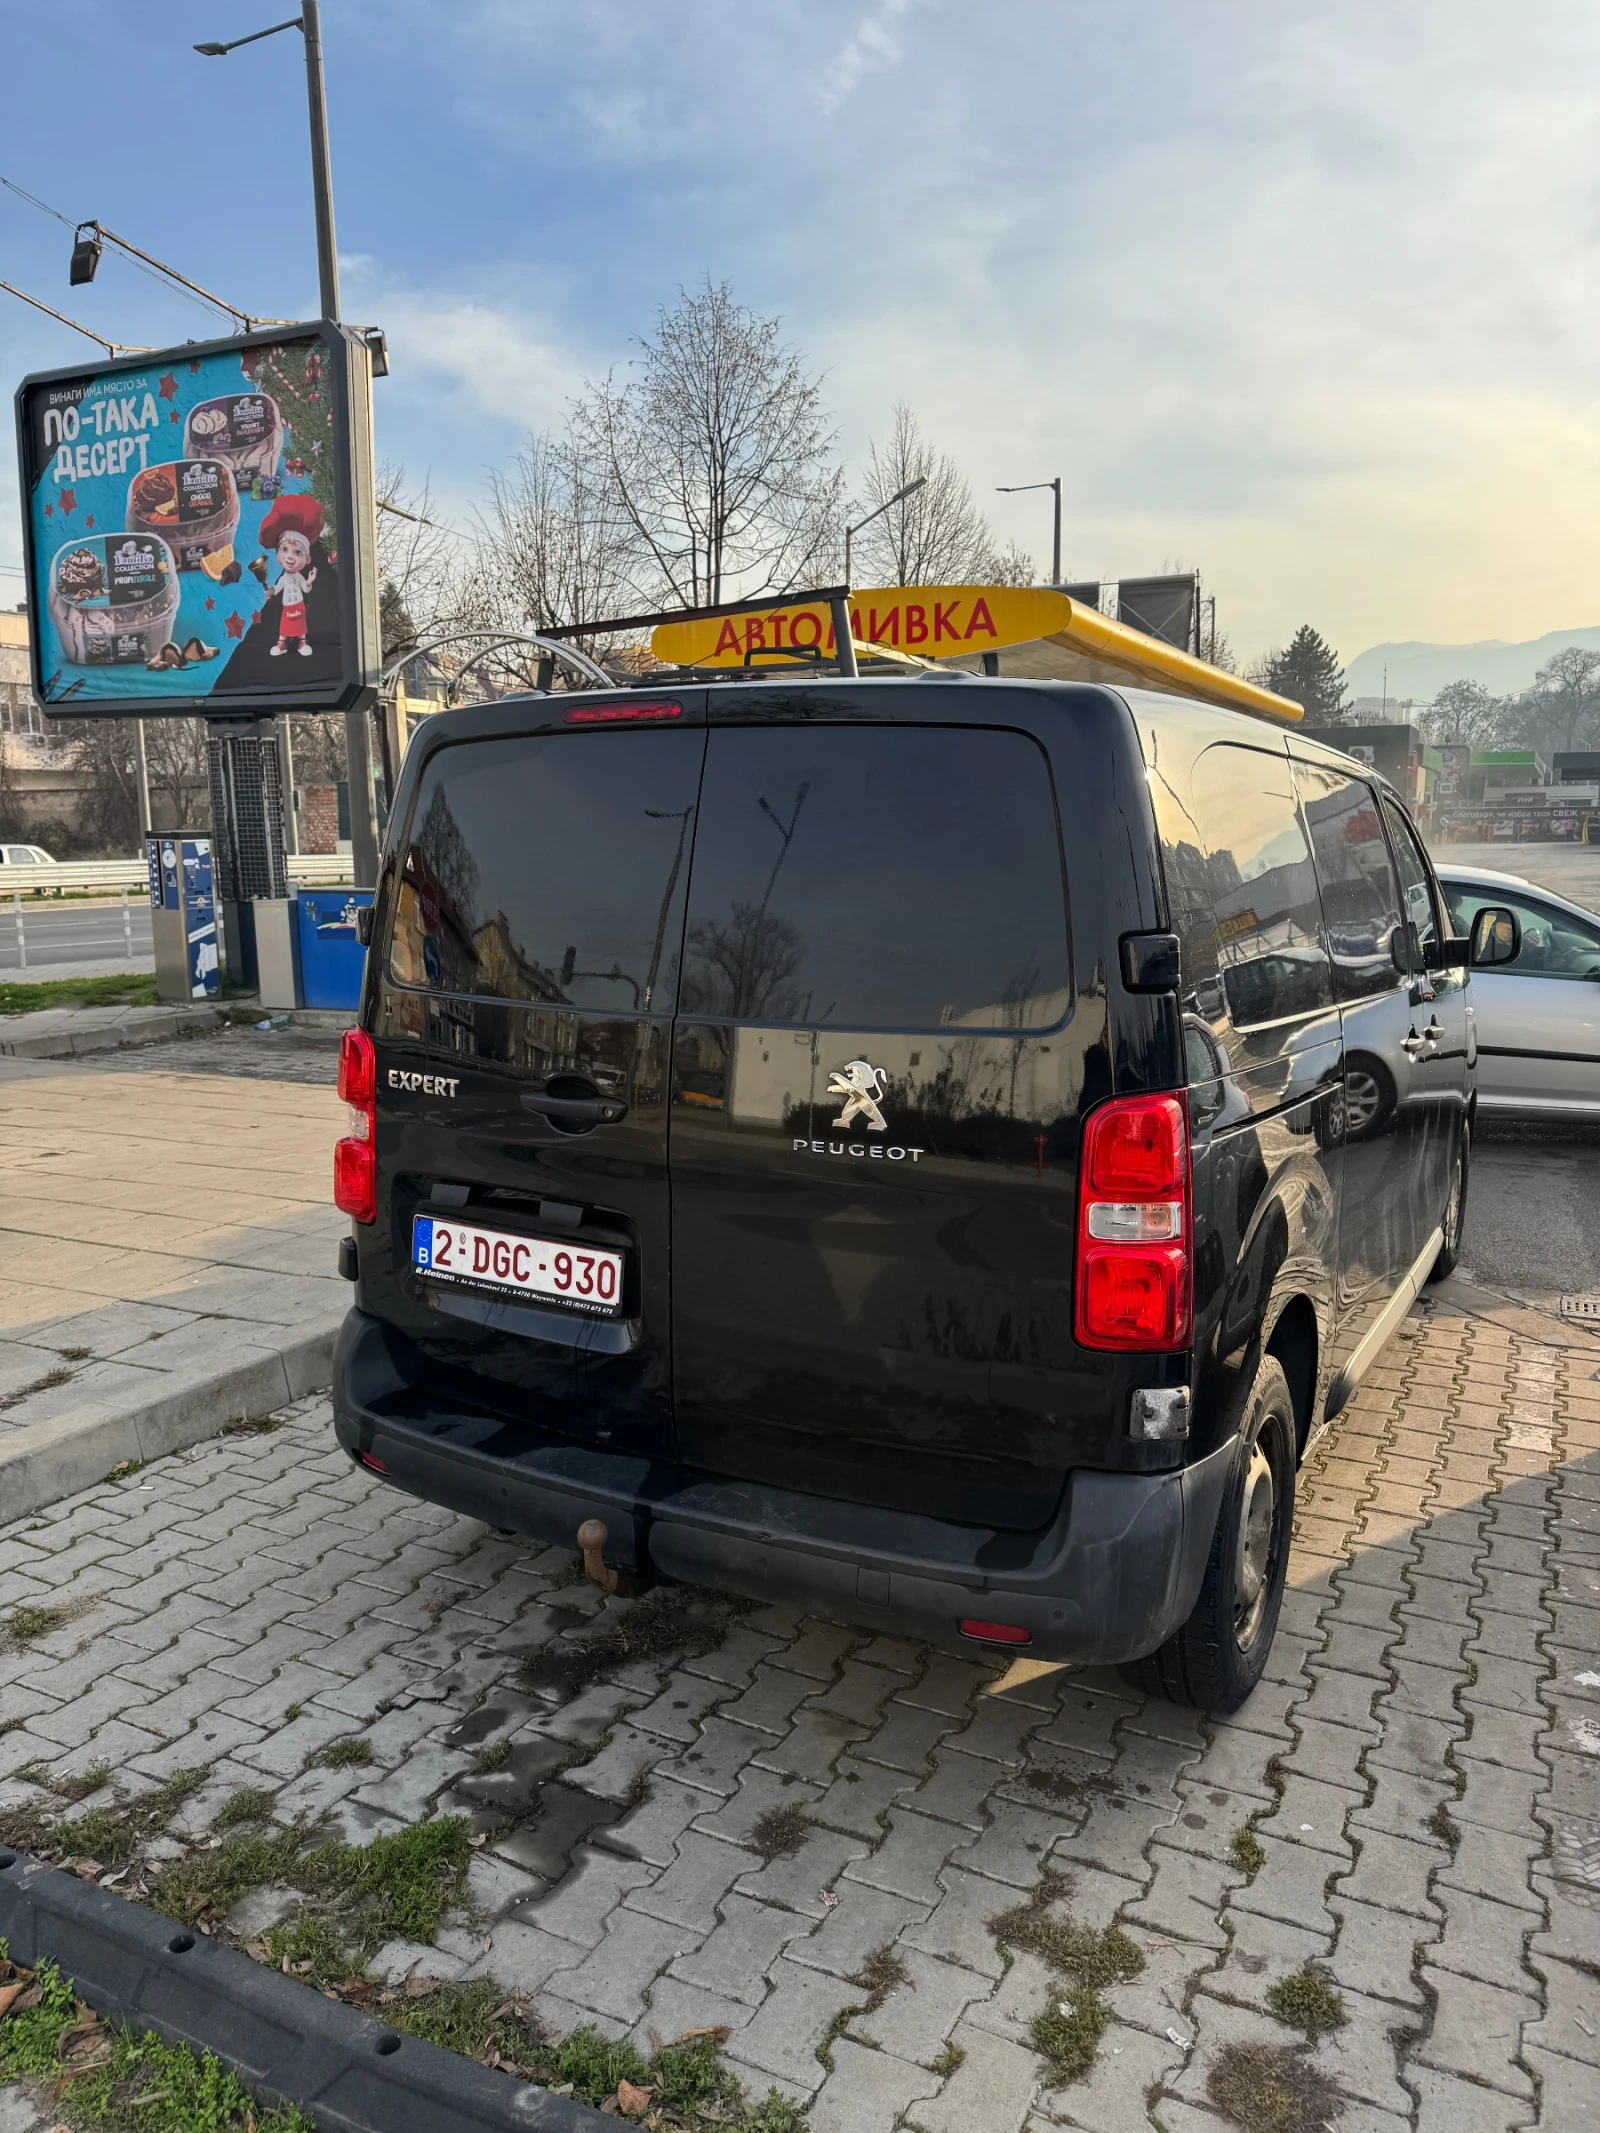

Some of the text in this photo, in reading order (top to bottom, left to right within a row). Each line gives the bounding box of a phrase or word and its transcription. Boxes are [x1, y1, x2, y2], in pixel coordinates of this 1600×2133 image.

[49, 378, 148, 405] ВИНАГИ ИМА МЯСТО ЗА
[43, 392, 159, 447] ПО-ТАКА
[233, 413, 264, 422] COLLECTION
[53, 433, 150, 484] ДЕСЕРТ
[183, 483, 218, 492] COLLECTION
[190, 492, 211, 500] CHOCO
[114, 563, 155, 573] COLLECTION
[114, 573, 157, 585] PROFITEROLE
[1452, 810, 1495, 818] Благодаря,
[1508, 809, 1531, 818] избра
[1553, 809, 1578, 817] СВЕЖ
[388, 1069, 460, 1098] EXPERT
[793, 1139, 925, 1162] PEUGEOT
[418, 1247, 429, 1264] B
[434, 1229, 616, 1299] 2-DGC-930
